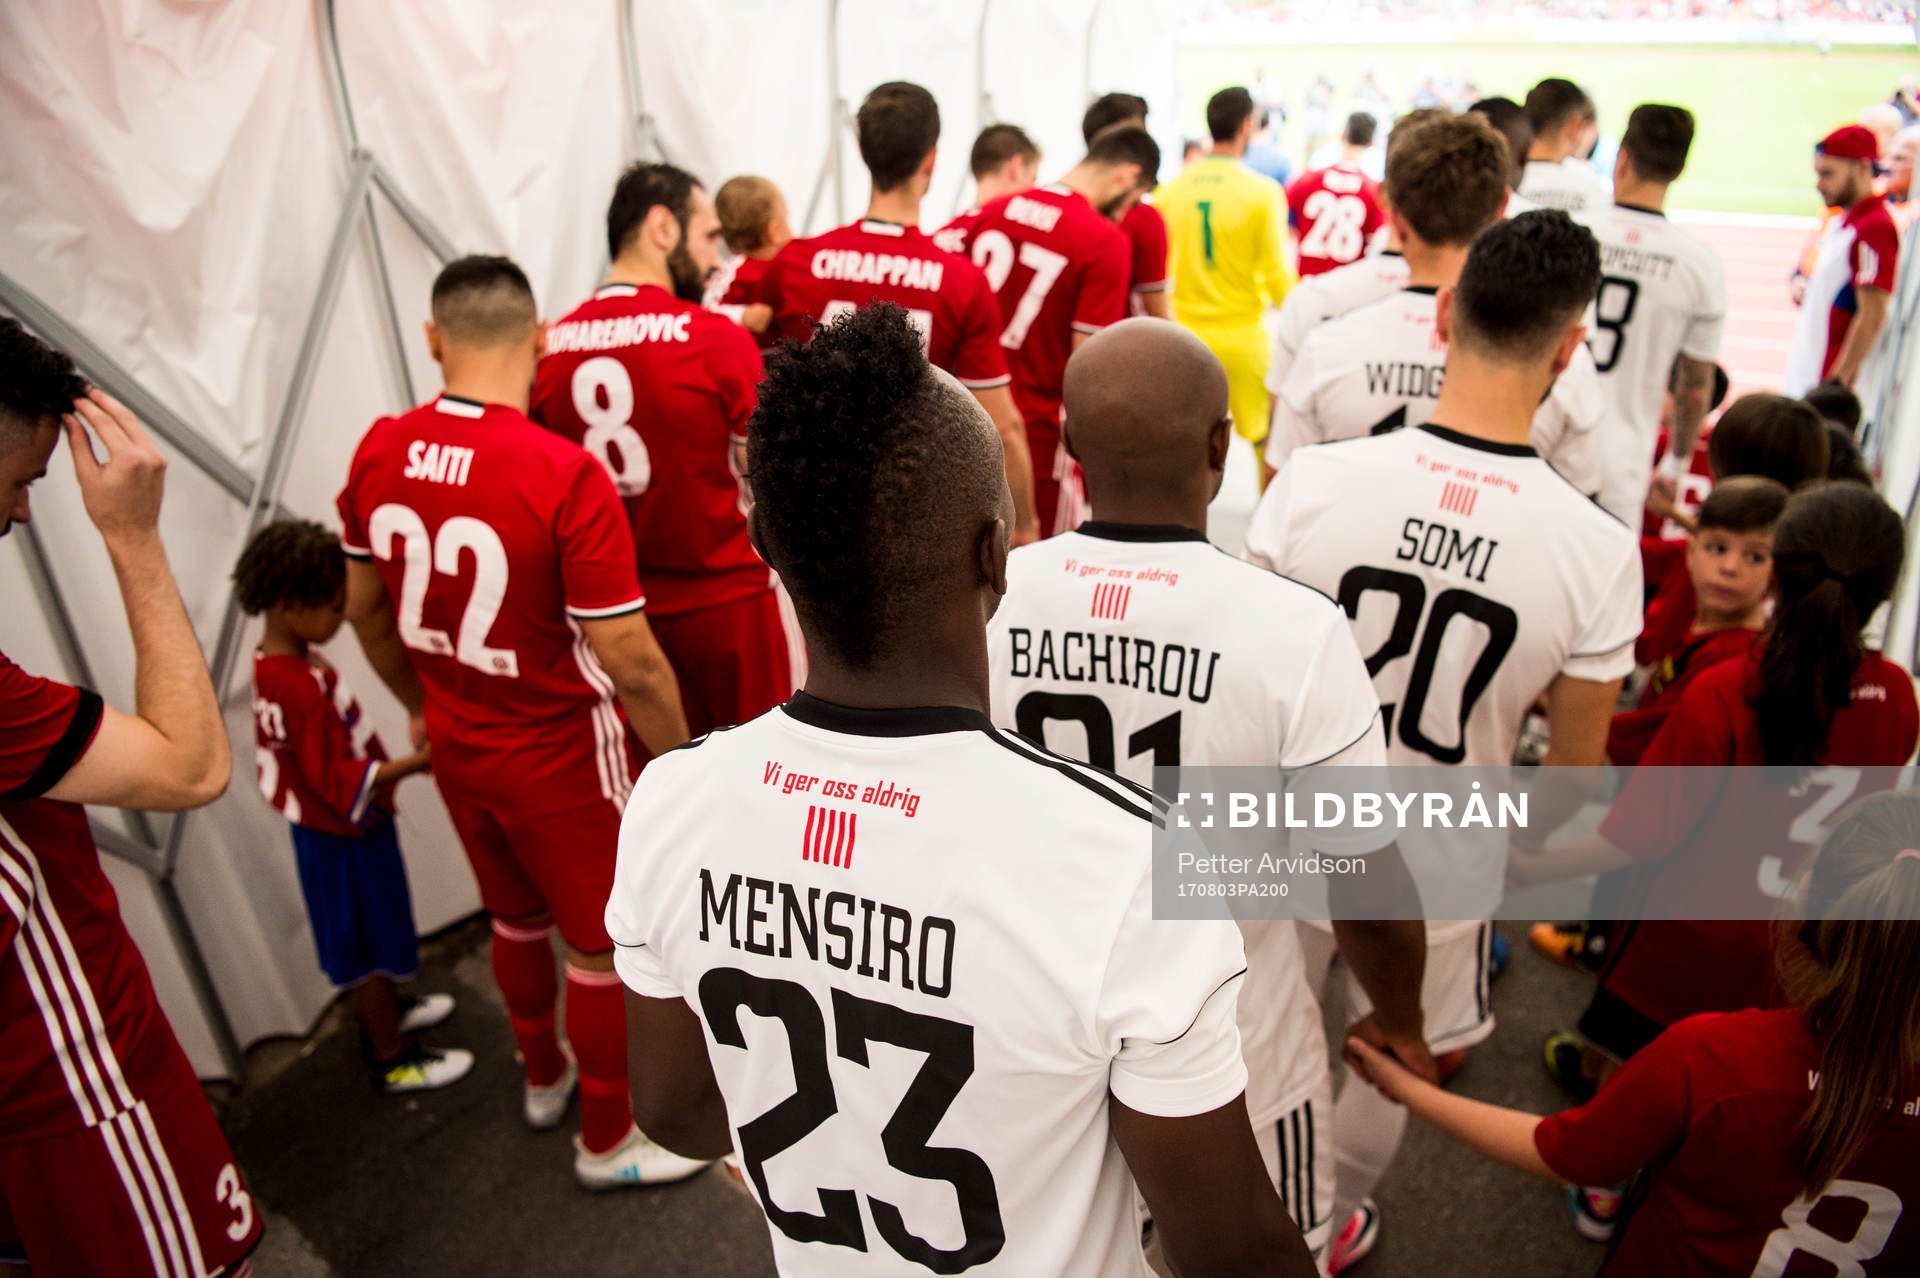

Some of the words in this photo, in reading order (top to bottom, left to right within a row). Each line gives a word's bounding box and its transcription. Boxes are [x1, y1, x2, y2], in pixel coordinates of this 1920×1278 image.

[1197, 201, 1215, 268] 1
[1302, 190, 1367, 263] 28
[811, 248, 944, 292] CHRAPPAN
[972, 230, 1069, 350] 27
[404, 440, 475, 486] SAITI
[571, 356, 652, 497] 8
[1064, 559, 1078, 572] Vi
[1079, 565, 1105, 577] ger
[1108, 568, 1133, 579] oss
[1136, 568, 1179, 587] aldrig
[1396, 518, 1498, 582] SOMI
[369, 502, 519, 678] 22
[1009, 628, 1221, 704] BACHIROU
[1338, 565, 1517, 764] 20
[763, 760, 782, 786] Vi
[782, 772, 819, 795] ger
[822, 779, 858, 800] oss
[861, 780, 921, 818] aldrig
[699, 868, 957, 999] MENSIRO
[698, 966, 1006, 1275] 23
[215, 1162, 254, 1242] 3
